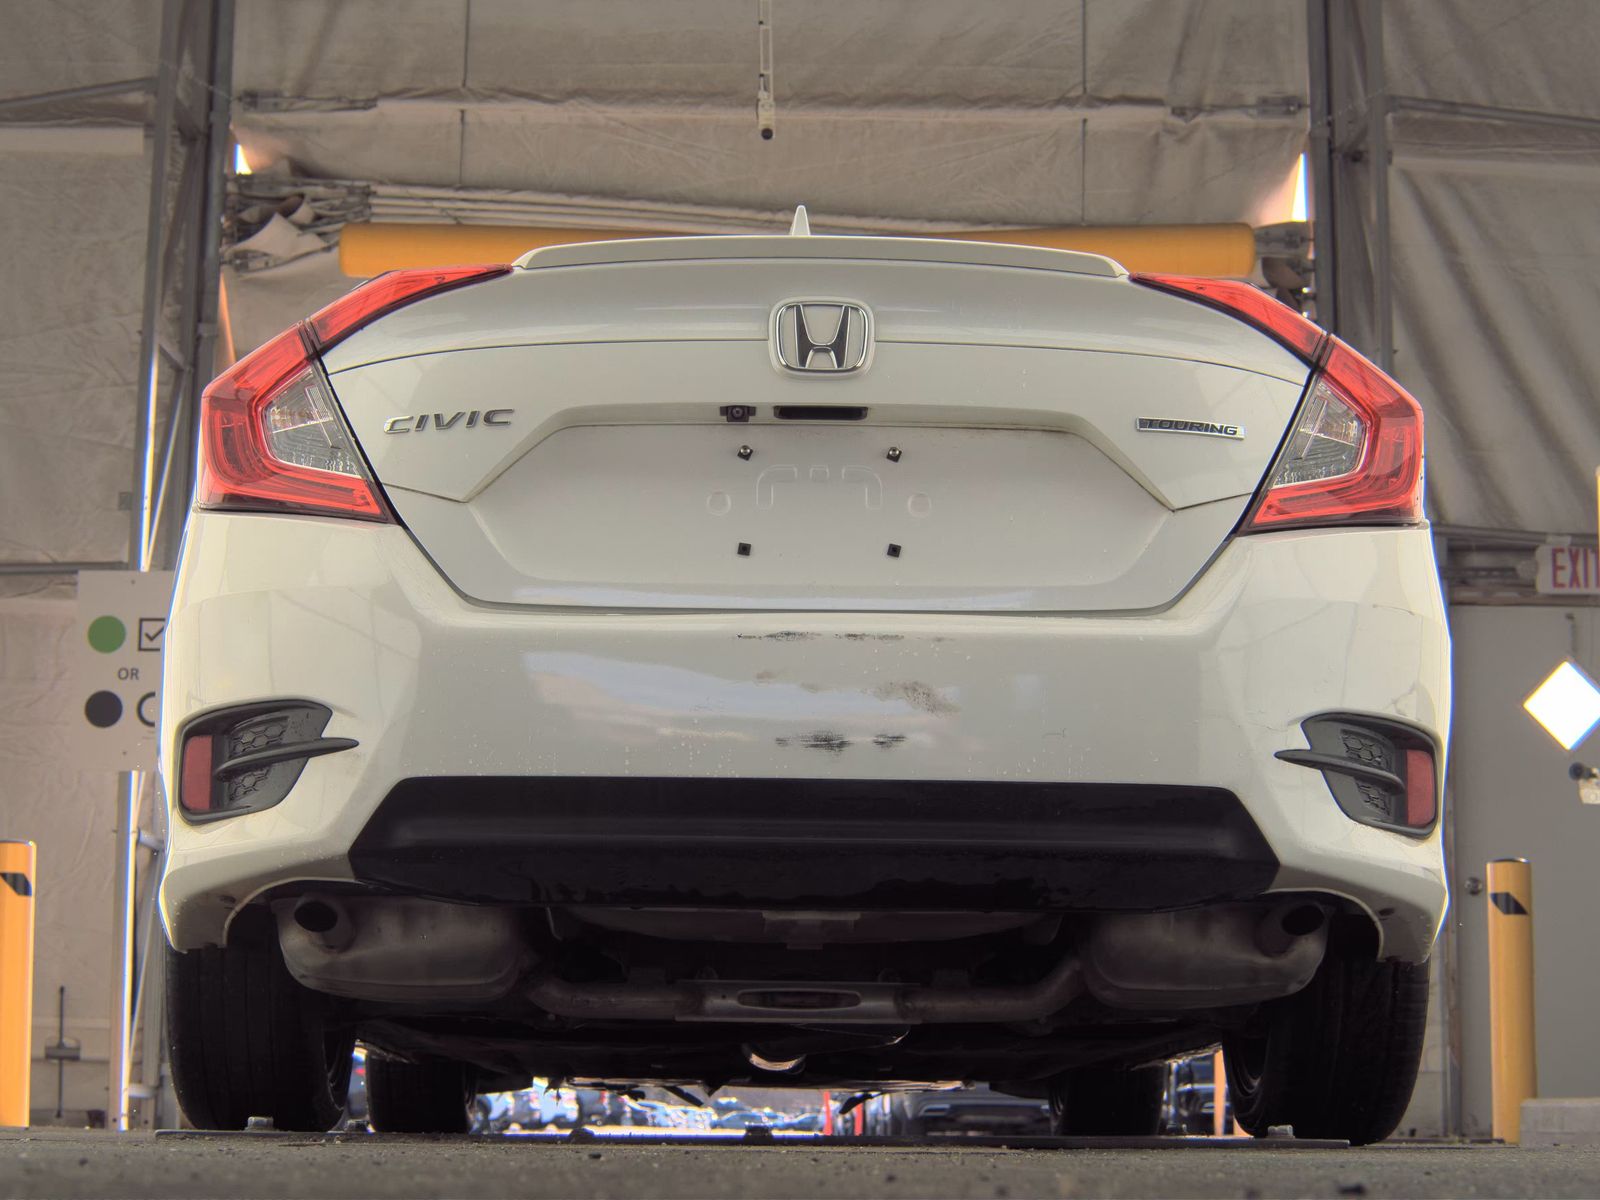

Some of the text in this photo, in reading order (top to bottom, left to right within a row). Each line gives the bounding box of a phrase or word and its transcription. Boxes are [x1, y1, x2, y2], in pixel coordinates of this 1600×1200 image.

[383, 408, 515, 434] CIVIC
[1141, 418, 1239, 437] TOURING
[117, 667, 140, 681] OR
